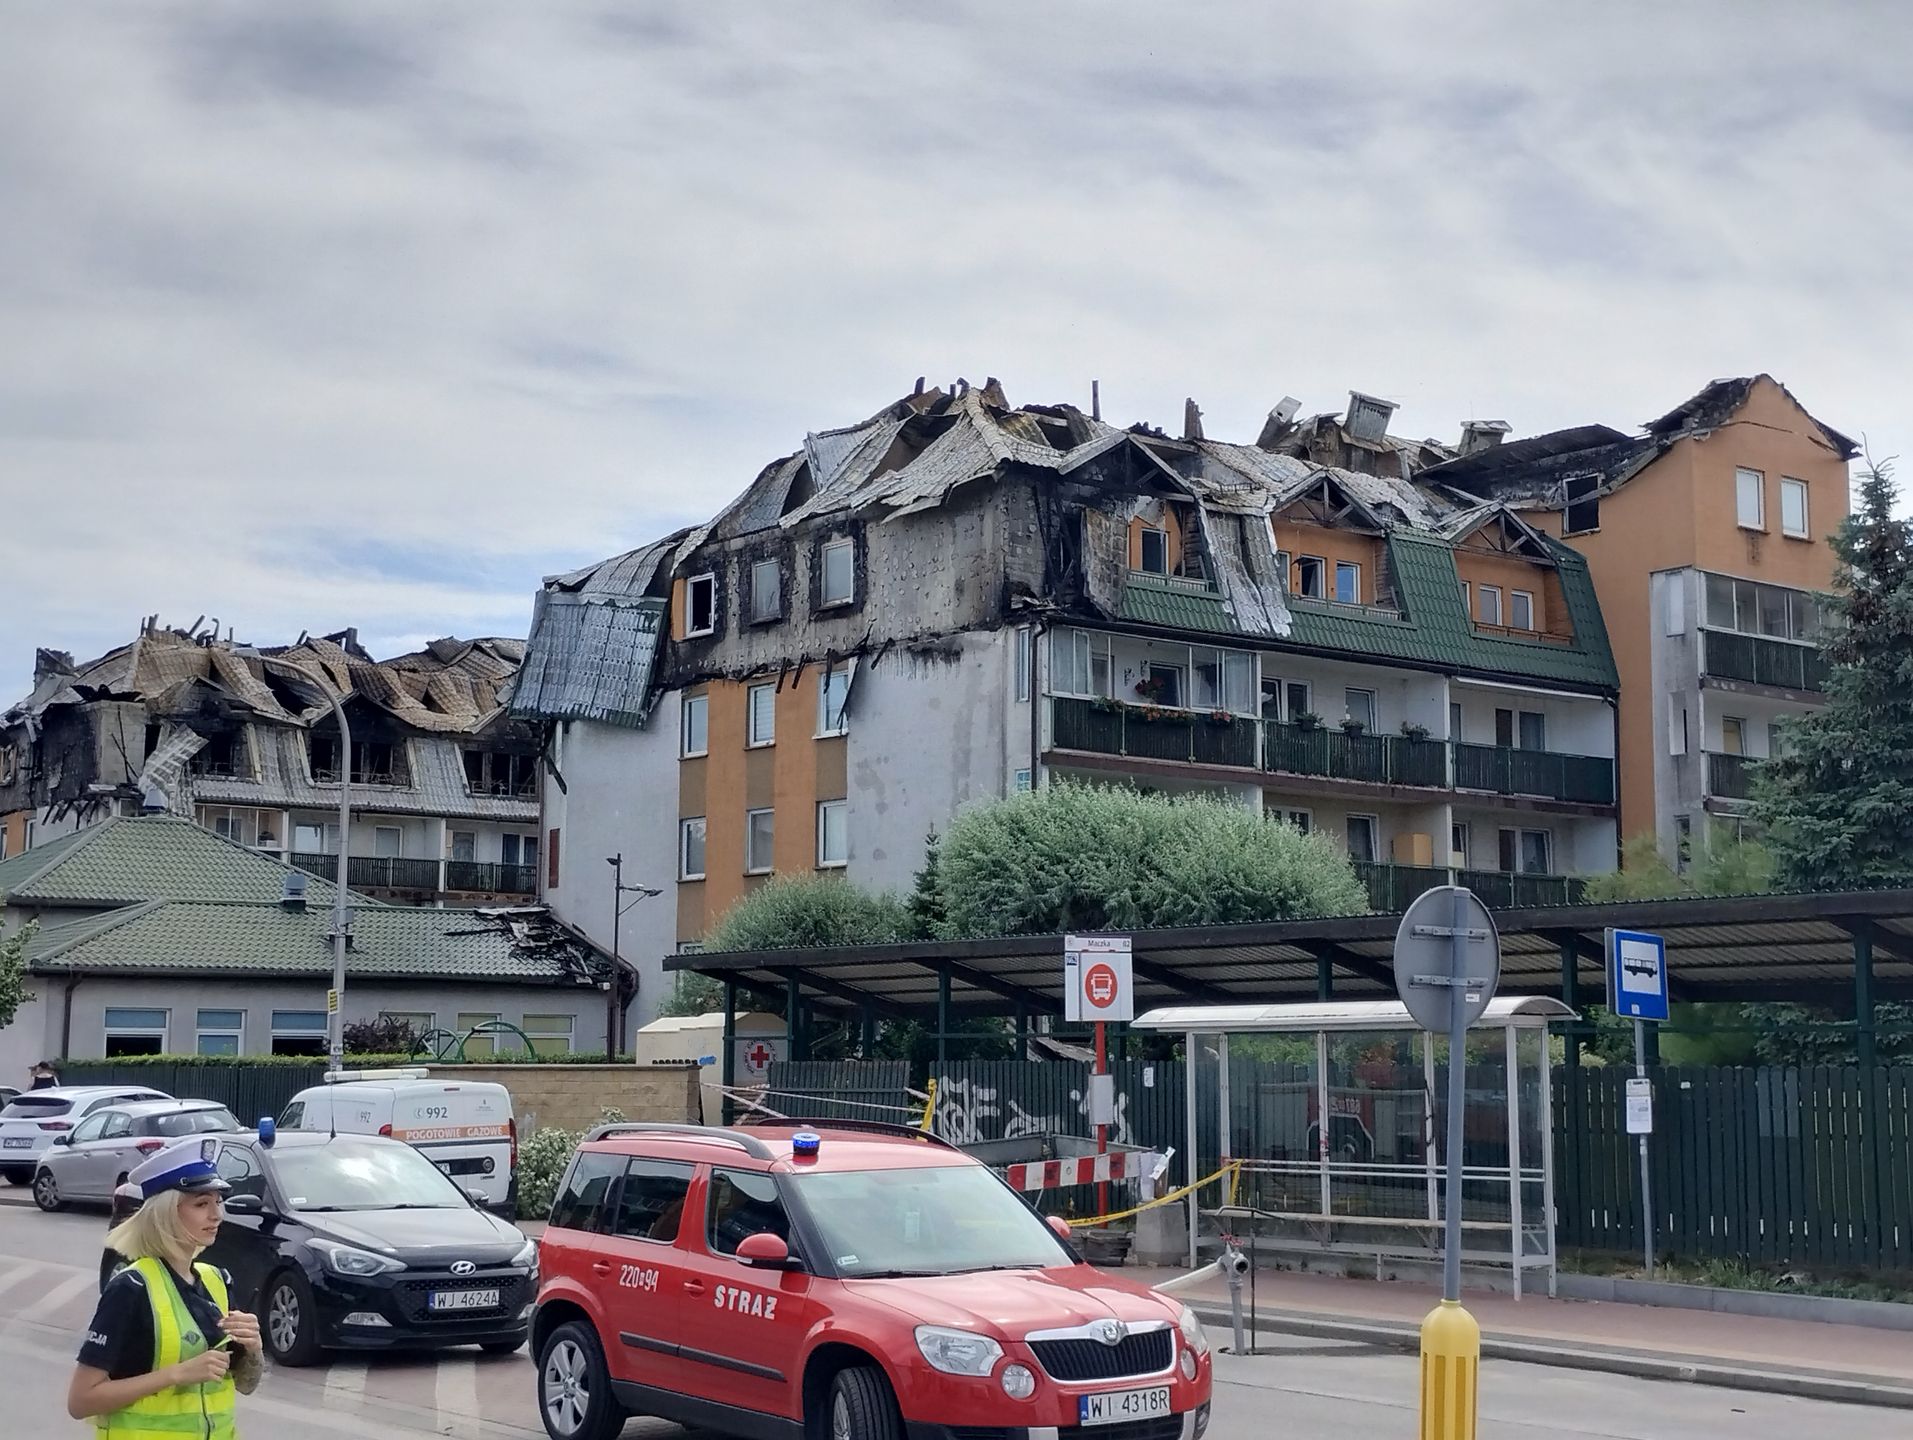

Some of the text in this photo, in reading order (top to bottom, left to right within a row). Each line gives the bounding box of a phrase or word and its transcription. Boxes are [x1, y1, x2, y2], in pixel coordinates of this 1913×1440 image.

[1088, 939, 1111, 947] Maczka
[360, 1111, 371, 1123] 992
[426, 1107, 448, 1119] 992
[406, 1126, 502, 1139] POGOTOWIE GAZOWE
[437, 1291, 498, 1307] WJ 4624A
[1091, 1389, 1168, 1417] WI 4318R
